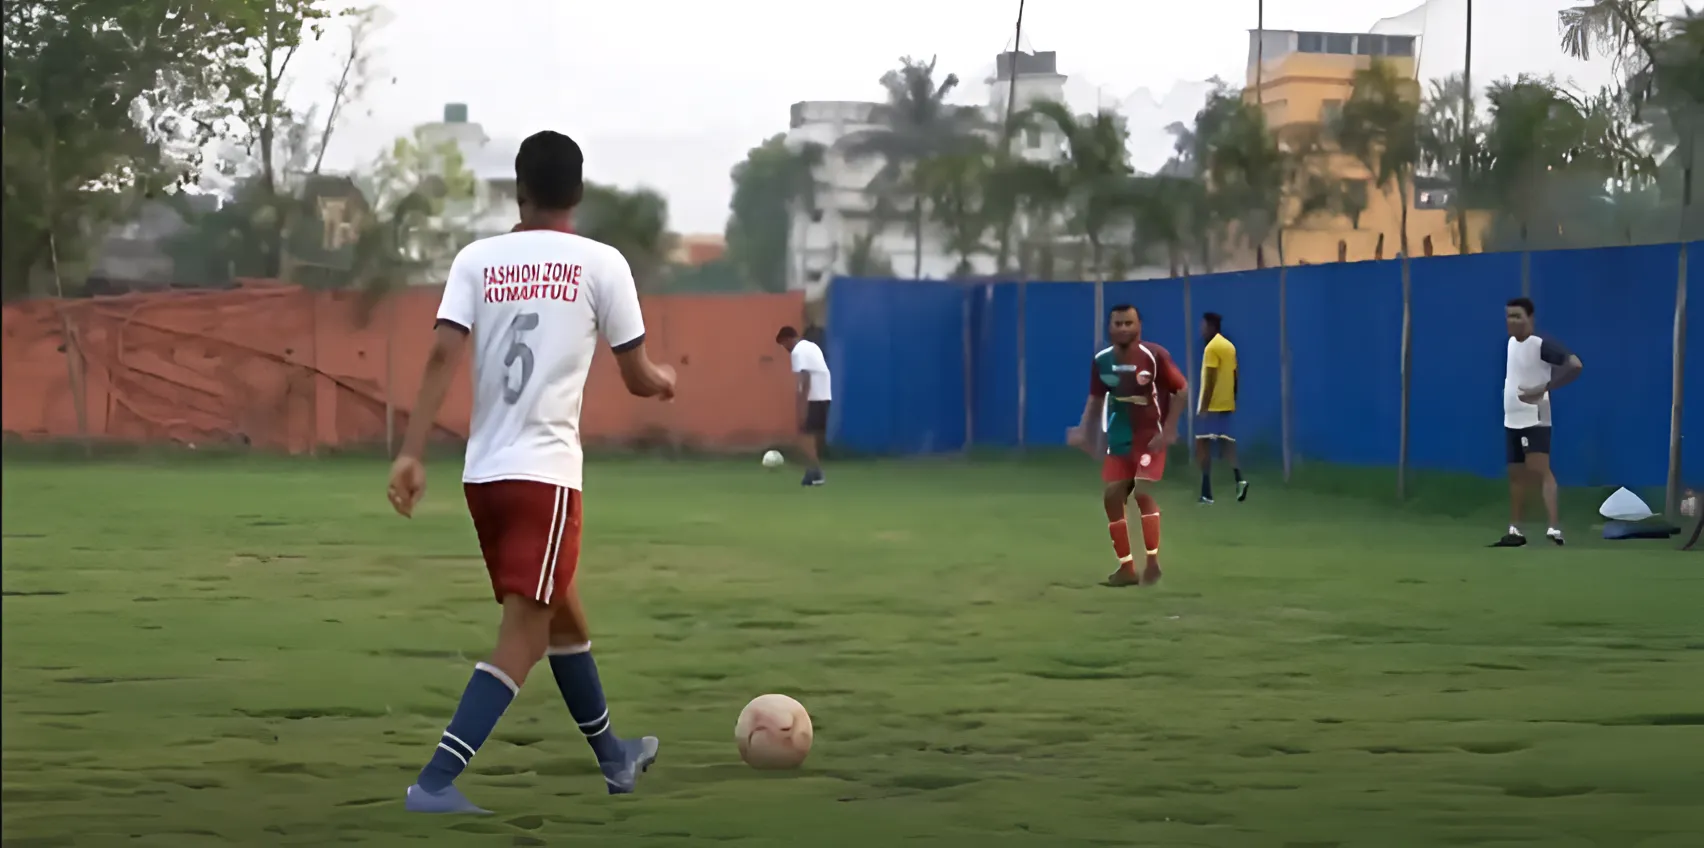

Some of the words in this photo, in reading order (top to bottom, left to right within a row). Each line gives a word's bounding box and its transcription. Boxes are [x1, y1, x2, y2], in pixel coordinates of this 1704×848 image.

[483, 264, 541, 286] FASHION
[542, 262, 582, 286] ZONE
[503, 312, 540, 405] 5
